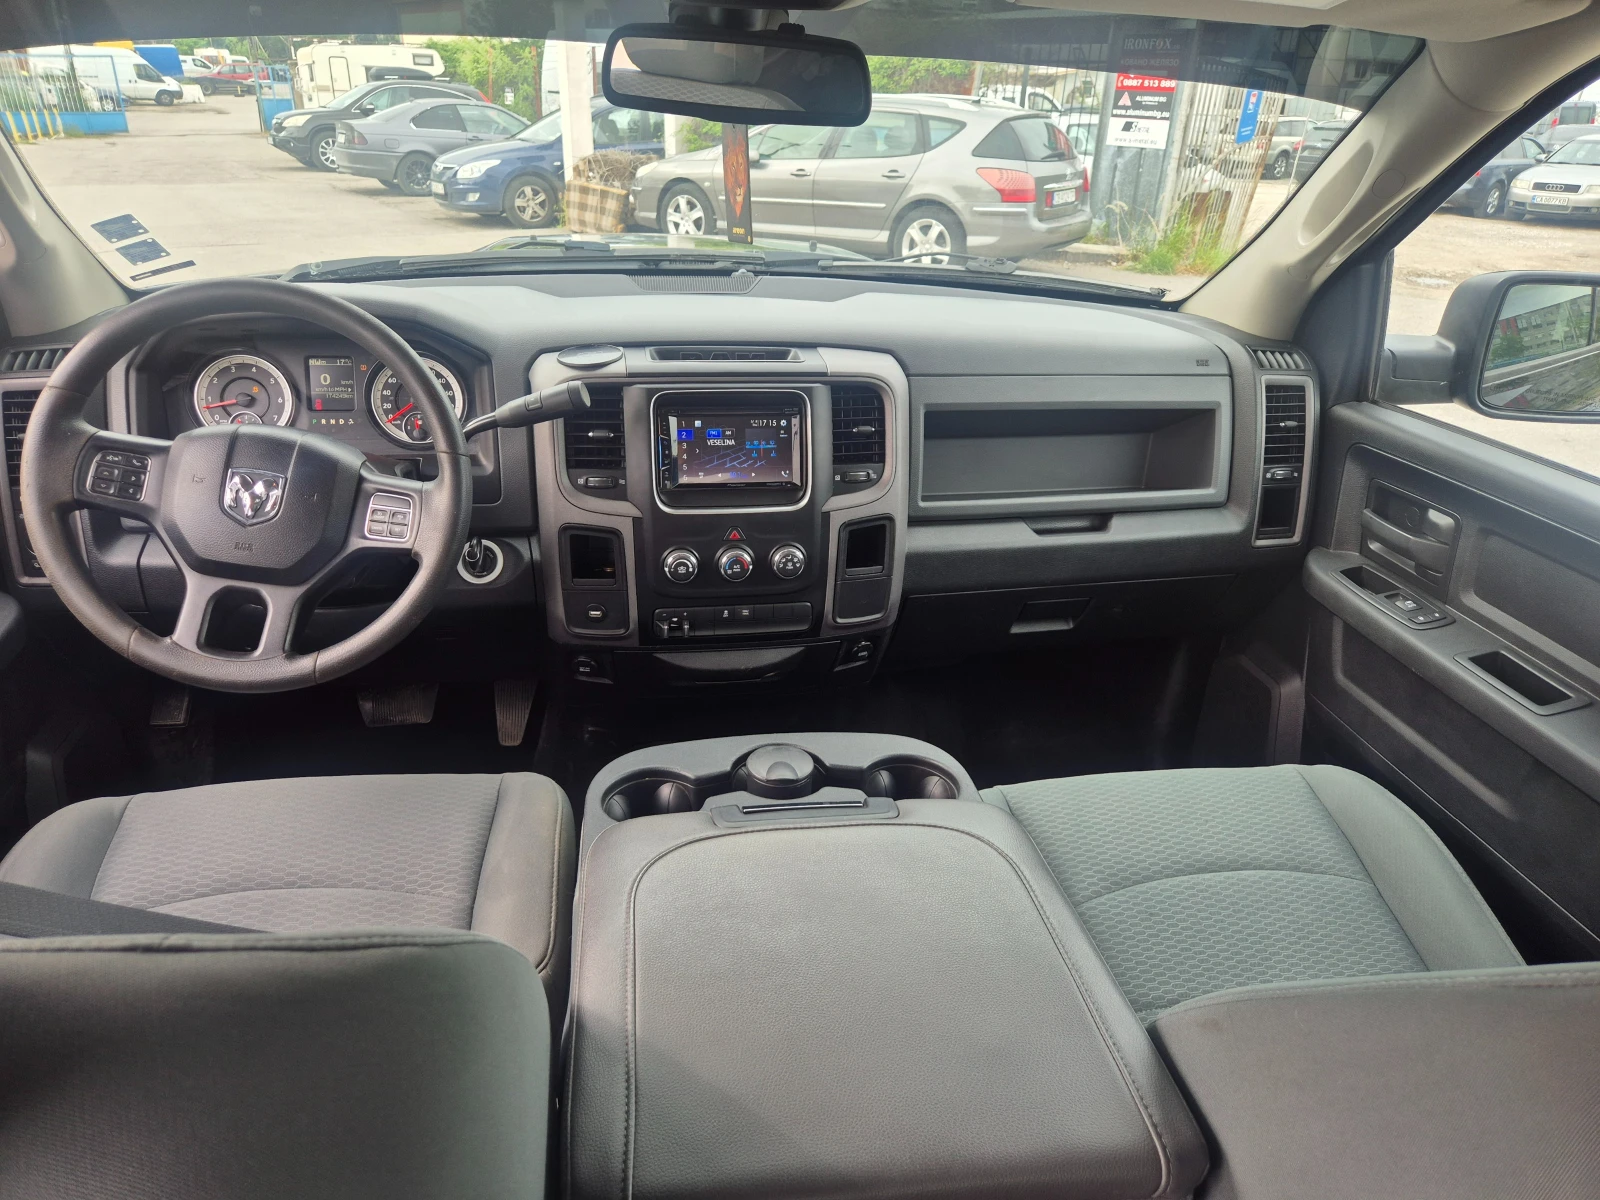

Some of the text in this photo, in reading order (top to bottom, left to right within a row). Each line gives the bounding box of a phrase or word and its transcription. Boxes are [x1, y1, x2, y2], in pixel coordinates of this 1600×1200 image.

[1124, 38, 1173, 50] IRONFOX
[1123, 78, 1176, 88] 0887 513 889
[1112, 109, 1170, 118] www.aluminumbg.eu
[320, 373, 331, 385] 0
